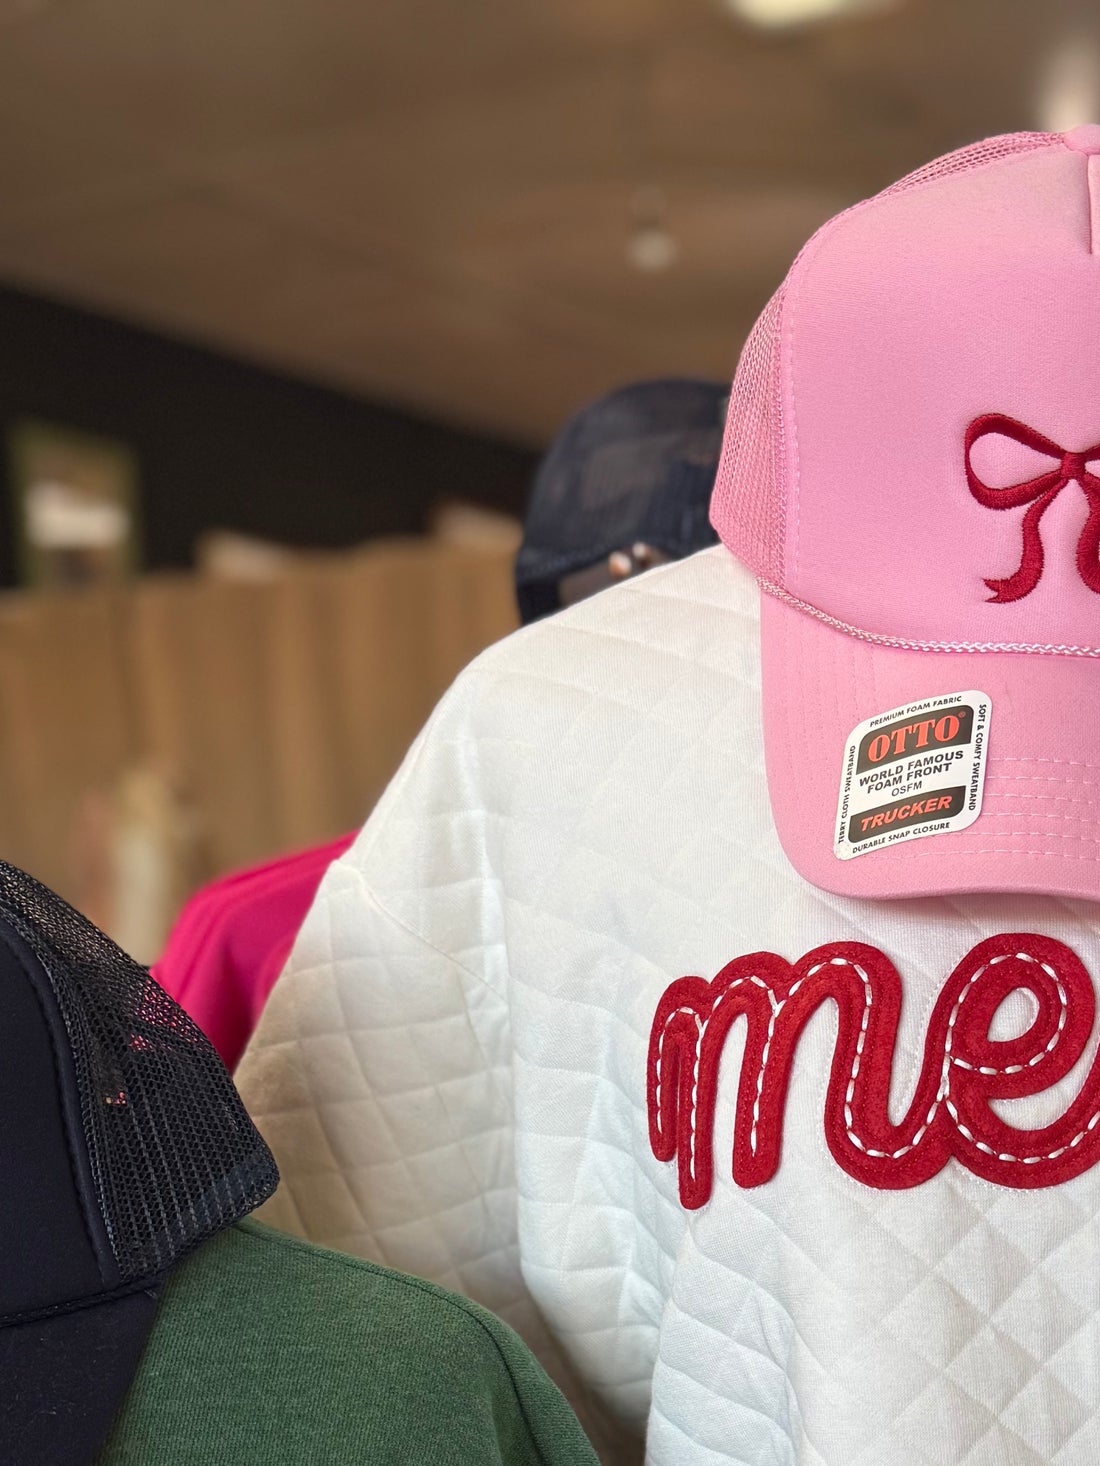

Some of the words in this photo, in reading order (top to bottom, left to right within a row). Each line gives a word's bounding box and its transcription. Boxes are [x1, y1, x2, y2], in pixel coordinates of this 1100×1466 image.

[869, 710, 904, 728] PREMIUM
[906, 703, 931, 714] FOAM
[933, 695, 962, 707] FABRIC
[977, 704, 987, 722] SOFT
[867, 715, 960, 762] OTTO
[973, 732, 984, 760] COMFY
[844, 745, 856, 793] SWEATBAND
[859, 765, 904, 787] WORLD
[907, 750, 964, 771] FAMOUS
[867, 775, 903, 794] FOAM
[906, 763, 953, 782] FRONT
[891, 781, 923, 797] OSFM
[968, 762, 981, 811] SWEATBAND
[841, 794, 850, 819] CLOTH
[861, 795, 953, 833] TRUCKER
[838, 821, 847, 844] TERRY
[852, 837, 886, 854] DURABLE
[888, 831, 911, 842] SNAP
[913, 821, 951, 835] CLOSURE
